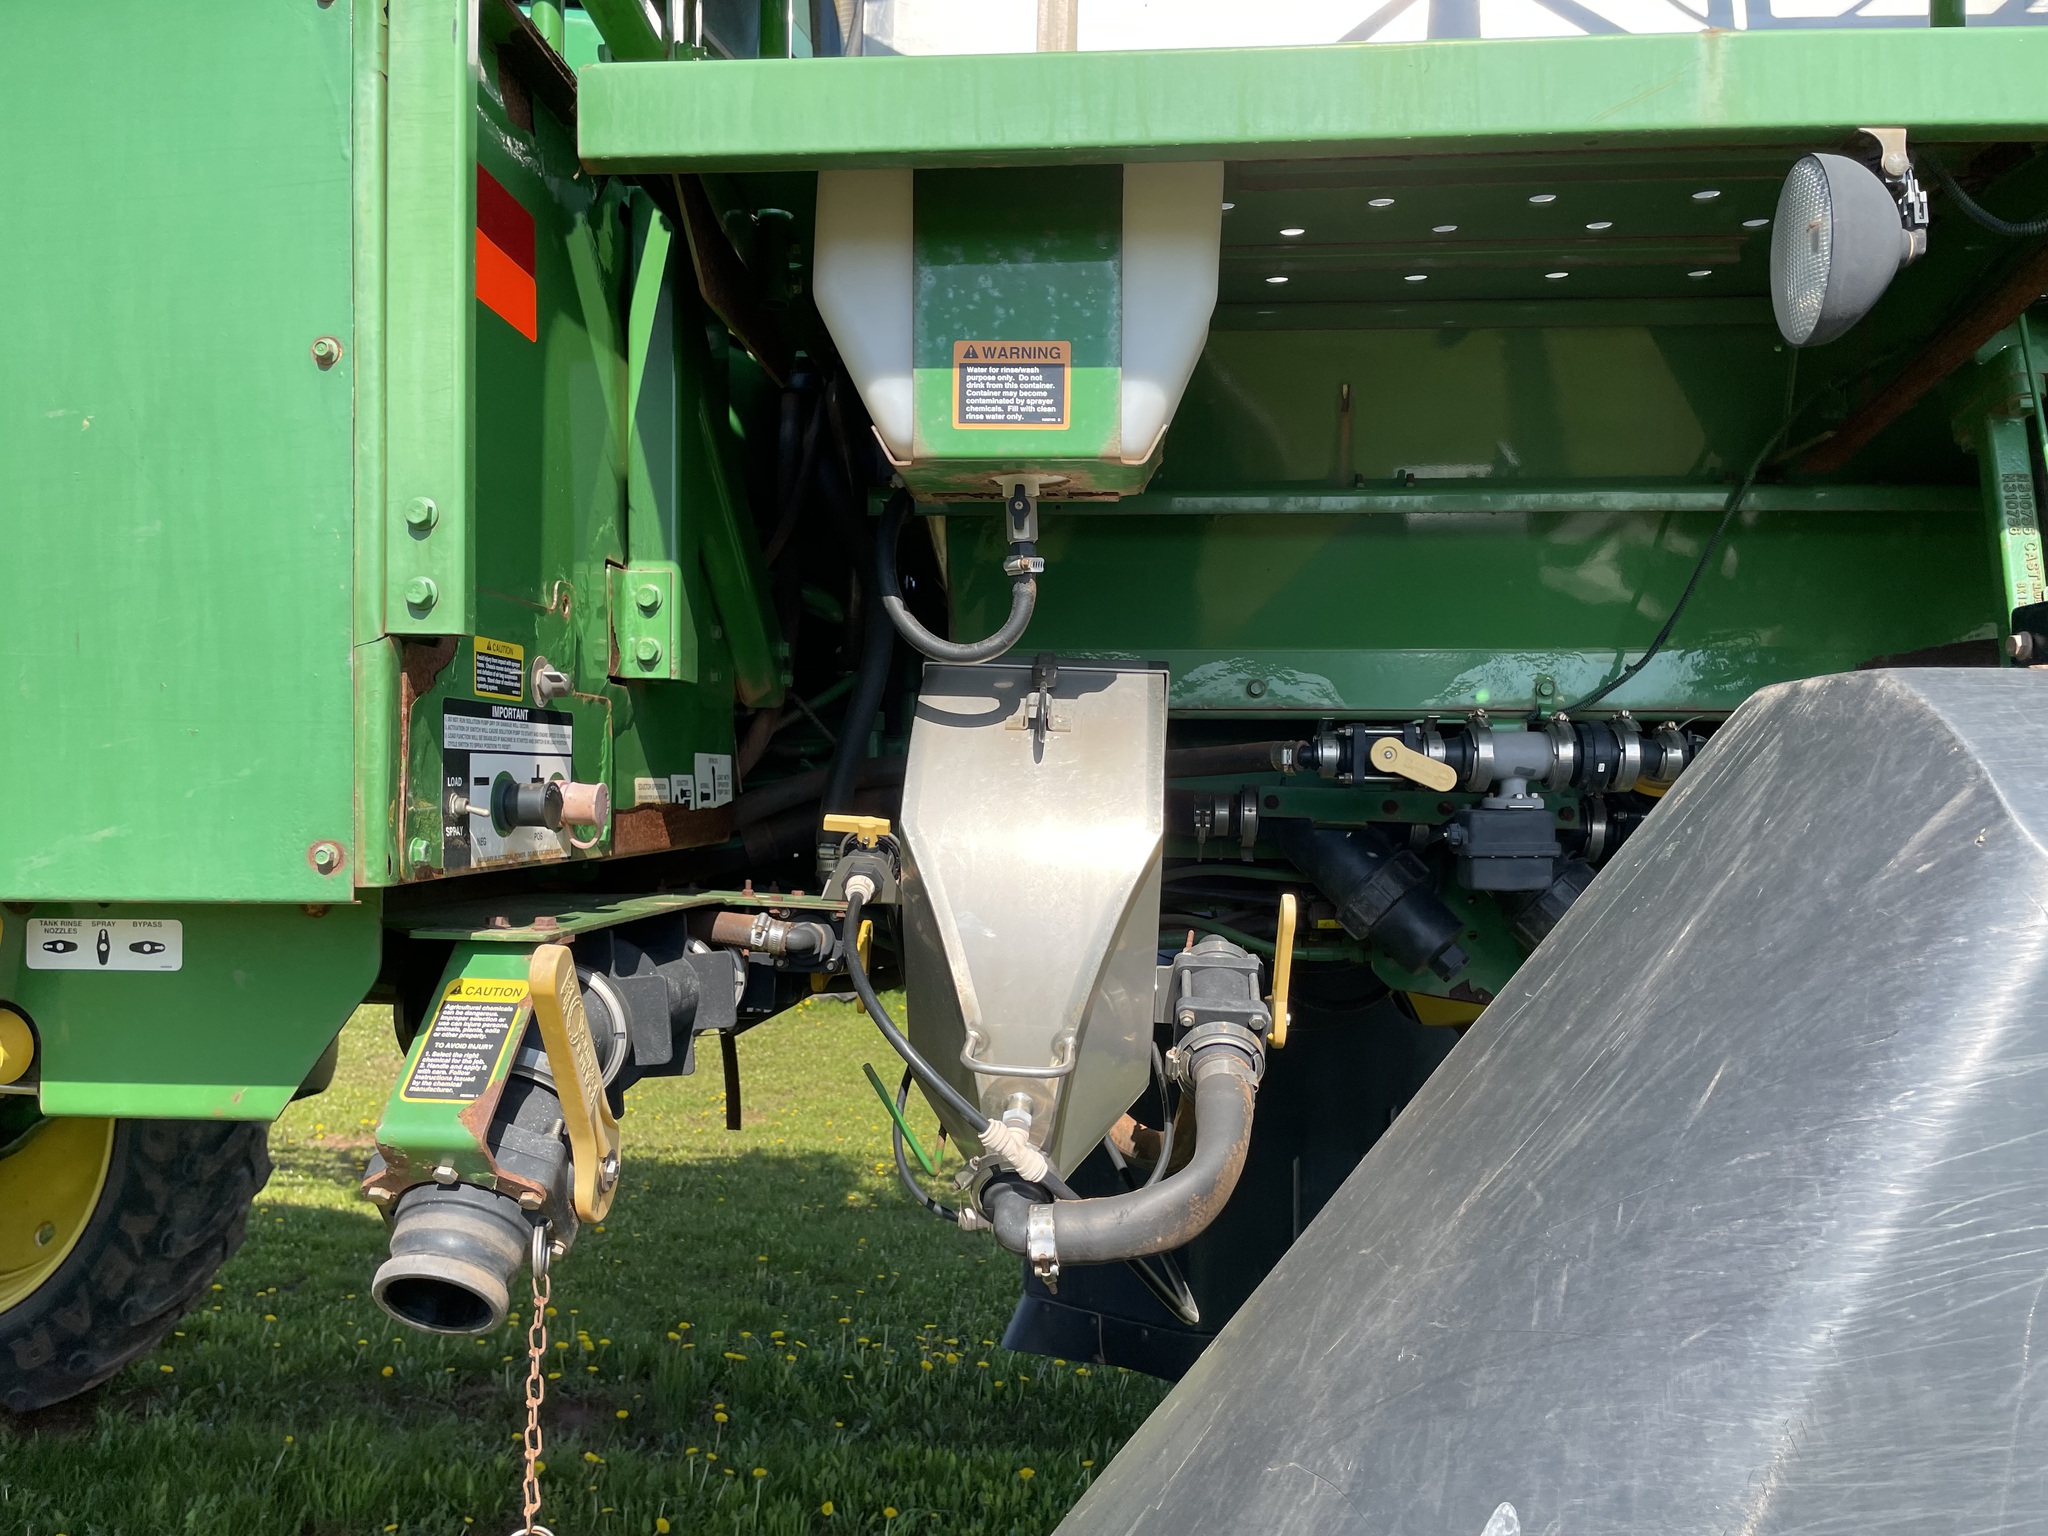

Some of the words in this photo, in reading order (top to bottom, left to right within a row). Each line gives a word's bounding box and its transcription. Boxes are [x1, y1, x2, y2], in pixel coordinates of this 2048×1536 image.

[982, 346, 1061, 359] WARNING
[997, 374, 1015, 383] only.
[1016, 398, 1025, 406] by
[1007, 413, 1024, 421] only.
[2024, 542, 2041, 580] CAST
[493, 644, 514, 655] CAUTION
[492, 706, 529, 721] IMPORTANT
[448, 777, 462, 787] LOAD
[446, 826, 464, 837] SPRAY
[534, 832, 544, 841] POS
[477, 837, 487, 846] NEG
[466, 986, 523, 997] CAUTION
[464, 1052, 479, 1060] right
